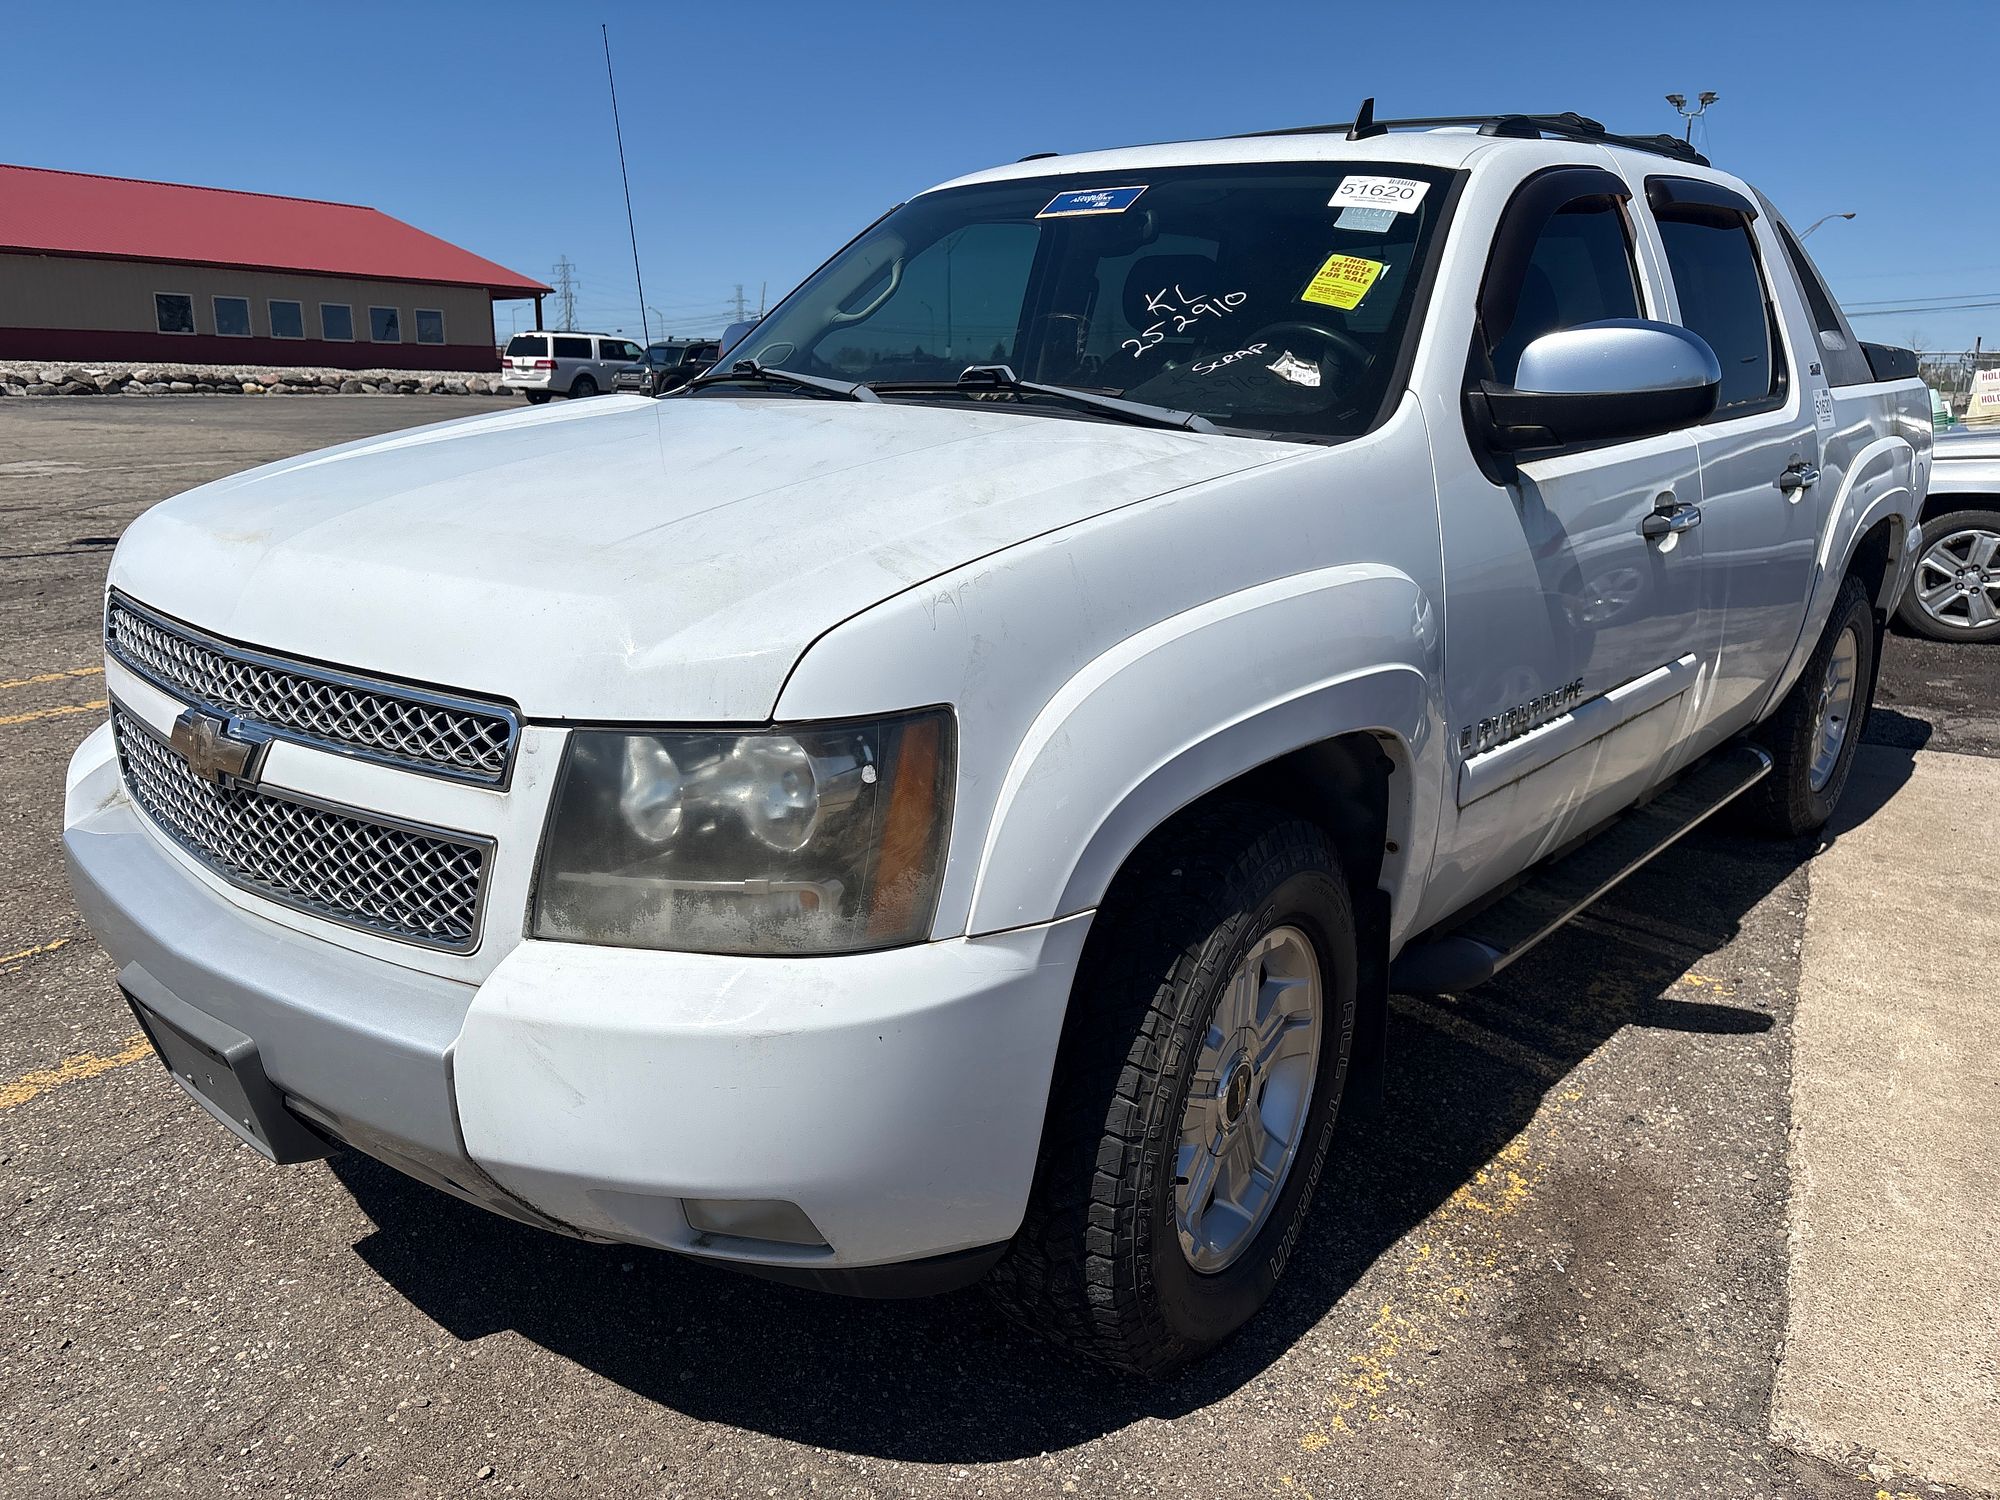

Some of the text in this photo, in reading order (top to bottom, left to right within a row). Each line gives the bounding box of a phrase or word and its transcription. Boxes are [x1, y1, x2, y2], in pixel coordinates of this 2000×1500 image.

[1340, 183, 1415, 200] 51620
[1331, 261, 1374, 274] VEHICLE
[1343, 257, 1369, 266] THIS
[1319, 271, 1341, 279] FOR
[1343, 274, 1370, 285] SALE
[1343, 269, 1367, 277] NOT
[1145, 283, 1208, 316] KL
[1982, 371, 2000, 381] HOL
[1268, 1000, 1357, 1281] ALL TERRAIN
